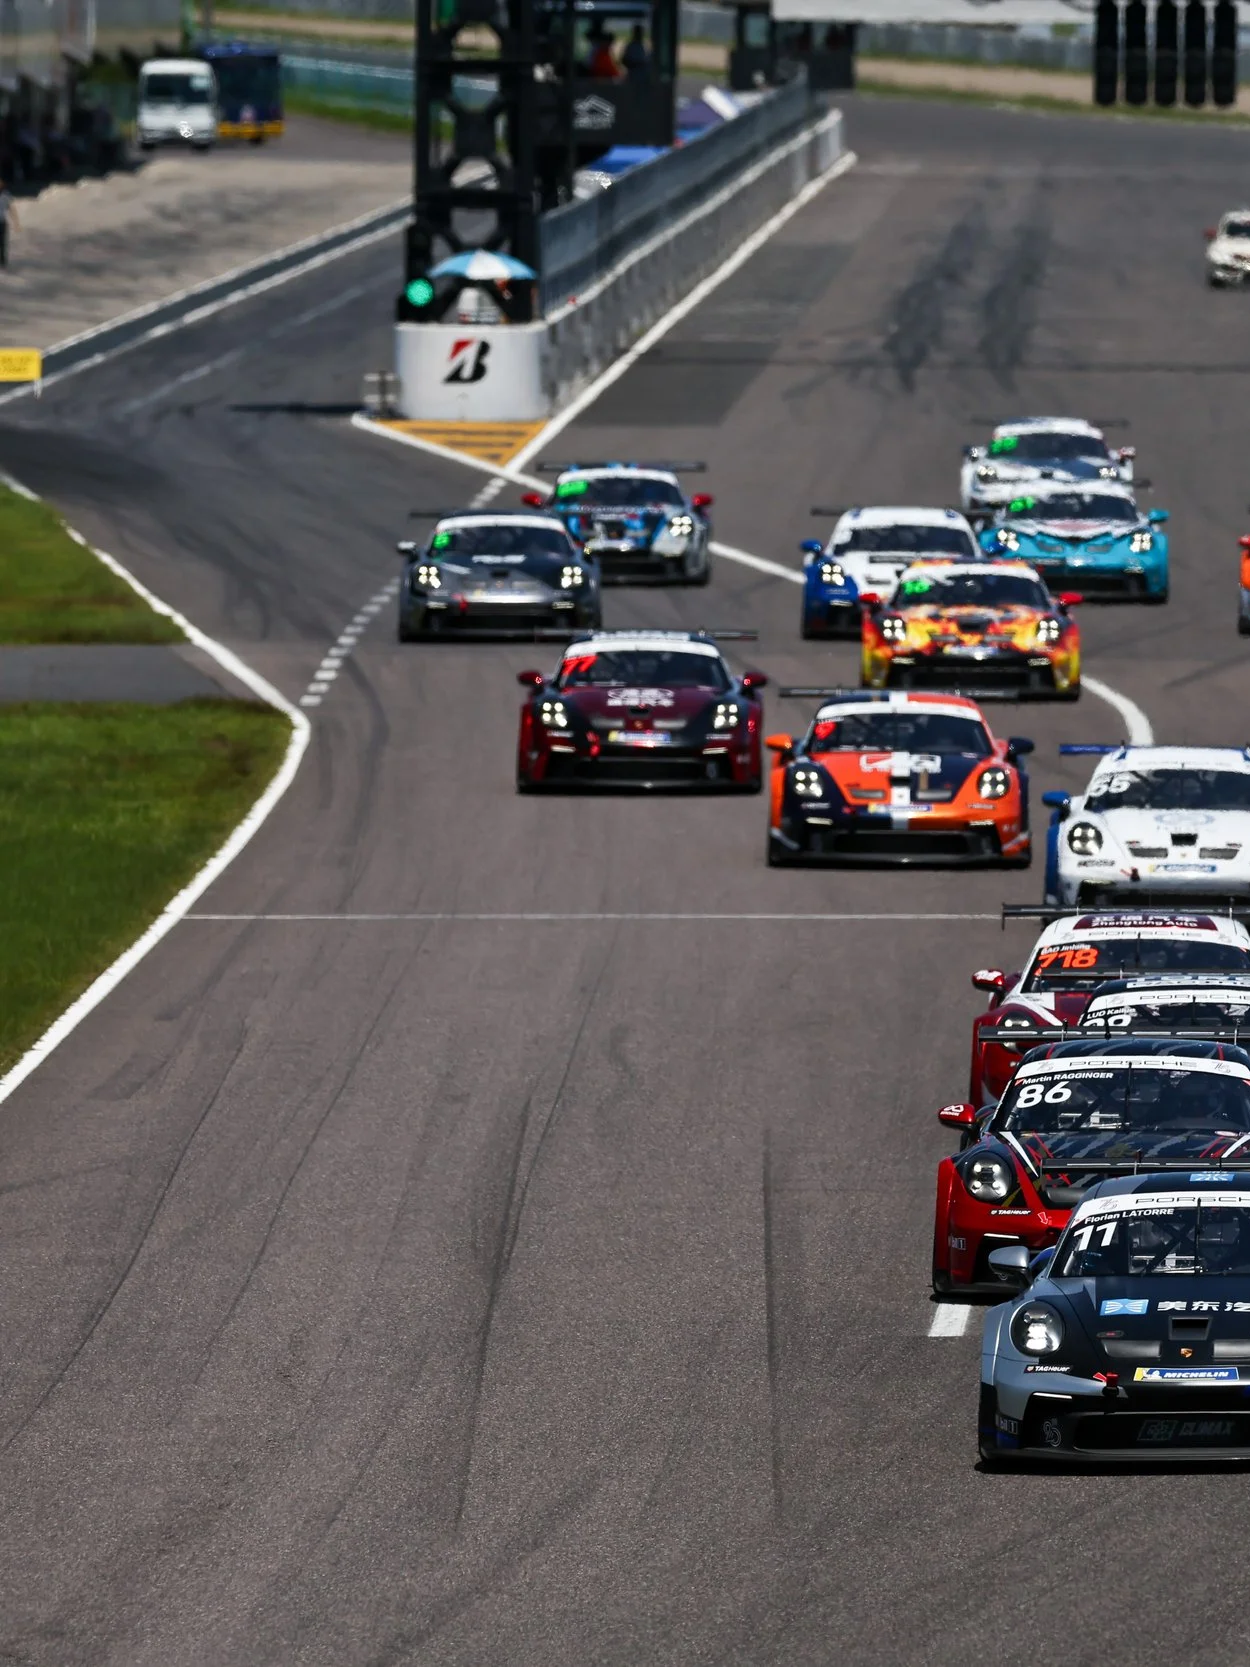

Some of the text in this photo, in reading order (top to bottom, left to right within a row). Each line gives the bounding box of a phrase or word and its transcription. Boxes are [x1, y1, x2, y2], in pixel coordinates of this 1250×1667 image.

[562, 655, 598, 676] 77
[1166, 919, 1198, 928] Auto
[1037, 947, 1099, 969] 718
[1086, 1009, 1109, 1020] LUO
[1069, 1060, 1198, 1068] PORSCHE
[1022, 1072, 1114, 1086] Martin RAGGINGER
[1016, 1081, 1073, 1109] 86
[1084, 1207, 1175, 1225] Florian LATORRE
[1073, 1221, 1118, 1252] 11
[1163, 1370, 1230, 1379] MICHELIN
